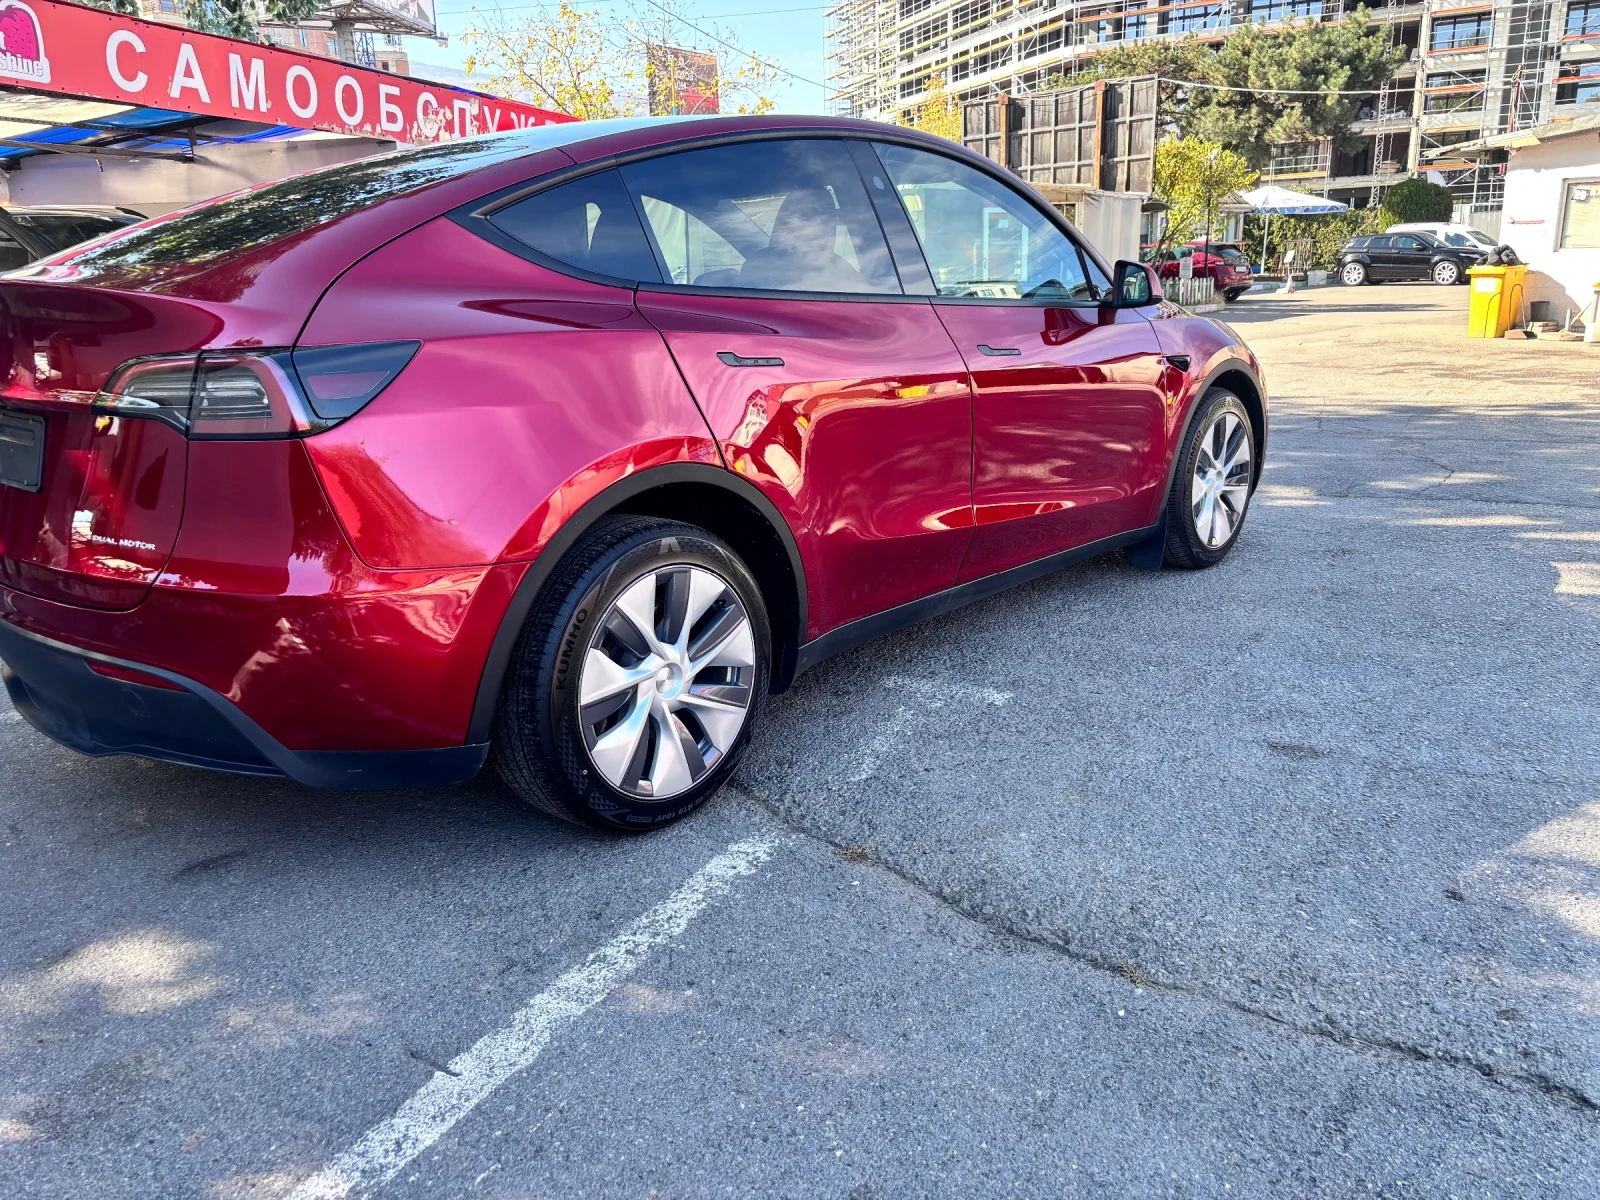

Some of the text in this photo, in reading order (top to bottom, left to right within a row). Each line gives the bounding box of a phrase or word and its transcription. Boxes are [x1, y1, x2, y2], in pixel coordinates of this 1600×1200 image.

[106, 29, 556, 138] САМООБСЛУЖ
[1186, 429, 1202, 474] KUMHO
[92, 535, 156, 550] DUAL MOTOR
[556, 608, 588, 690] KUMHO
